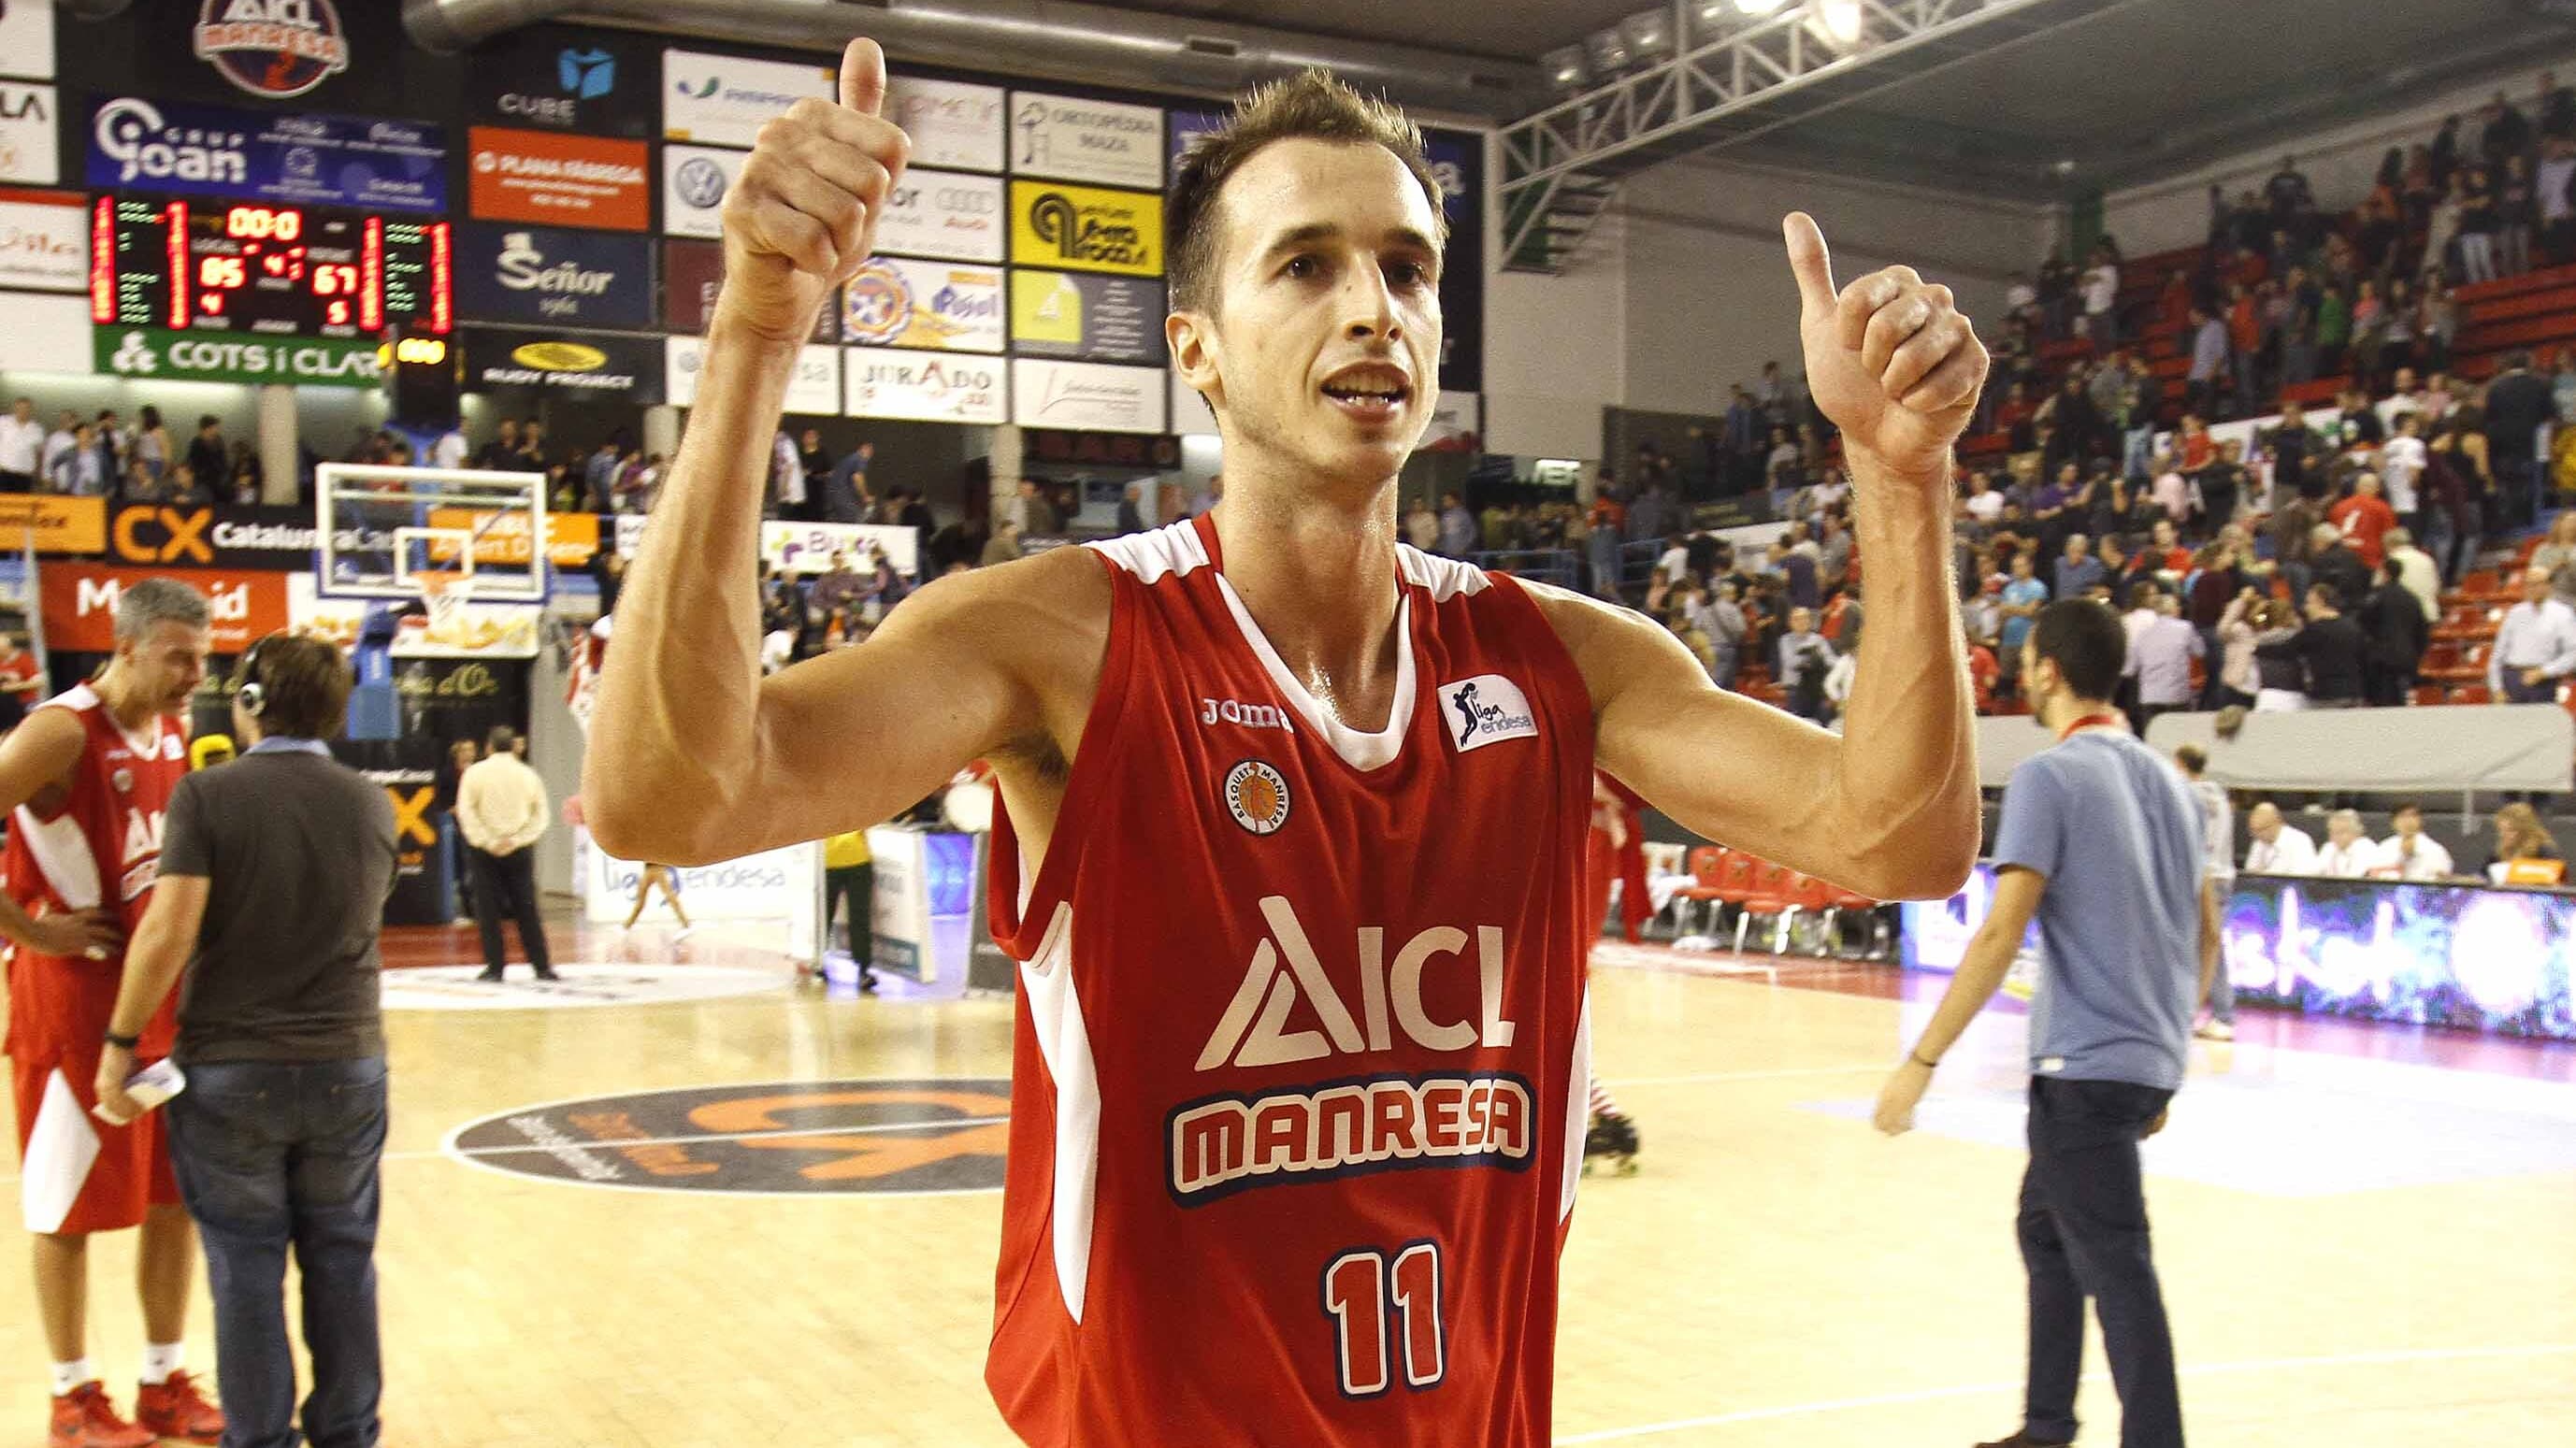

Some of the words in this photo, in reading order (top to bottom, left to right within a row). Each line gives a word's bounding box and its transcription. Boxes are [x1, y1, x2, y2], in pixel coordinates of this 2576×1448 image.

[496, 248, 615, 296] Señor
[169, 339, 269, 372] COTS
[112, 504, 214, 565] CX
[1470, 698, 1506, 722] liga
[1230, 767, 1251, 820] BASQUET
[1260, 768, 1287, 824] MANRESA
[1194, 895, 1518, 1072] AICL
[1171, 1077, 1533, 1197] MANRESA
[1322, 1241, 1446, 1397] 11
